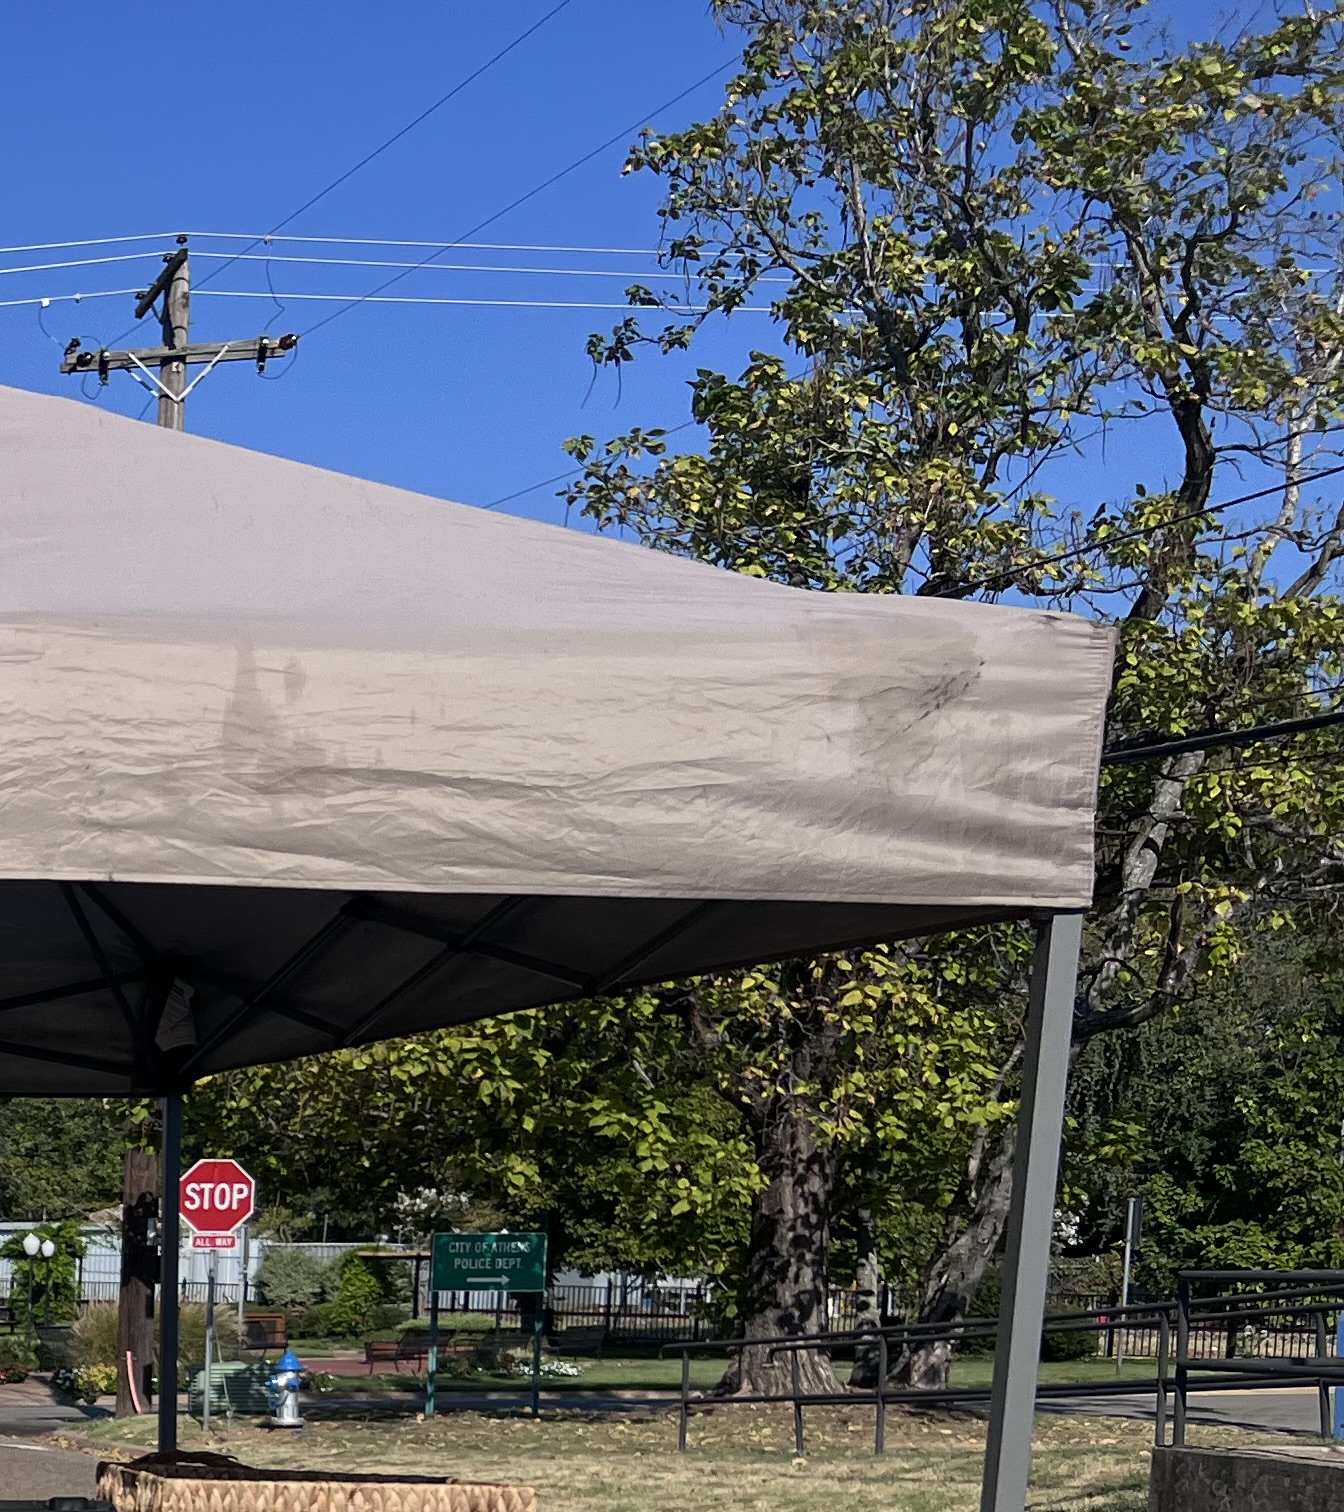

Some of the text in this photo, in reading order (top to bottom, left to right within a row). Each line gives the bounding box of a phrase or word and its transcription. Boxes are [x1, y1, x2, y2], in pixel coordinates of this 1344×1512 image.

[184, 1182, 249, 1211] STOP
[195, 1238, 232, 1247] ALL WAY
[448, 1241, 531, 1254] CITY OF ATHENS
[454, 1258, 492, 1270] POLICE
